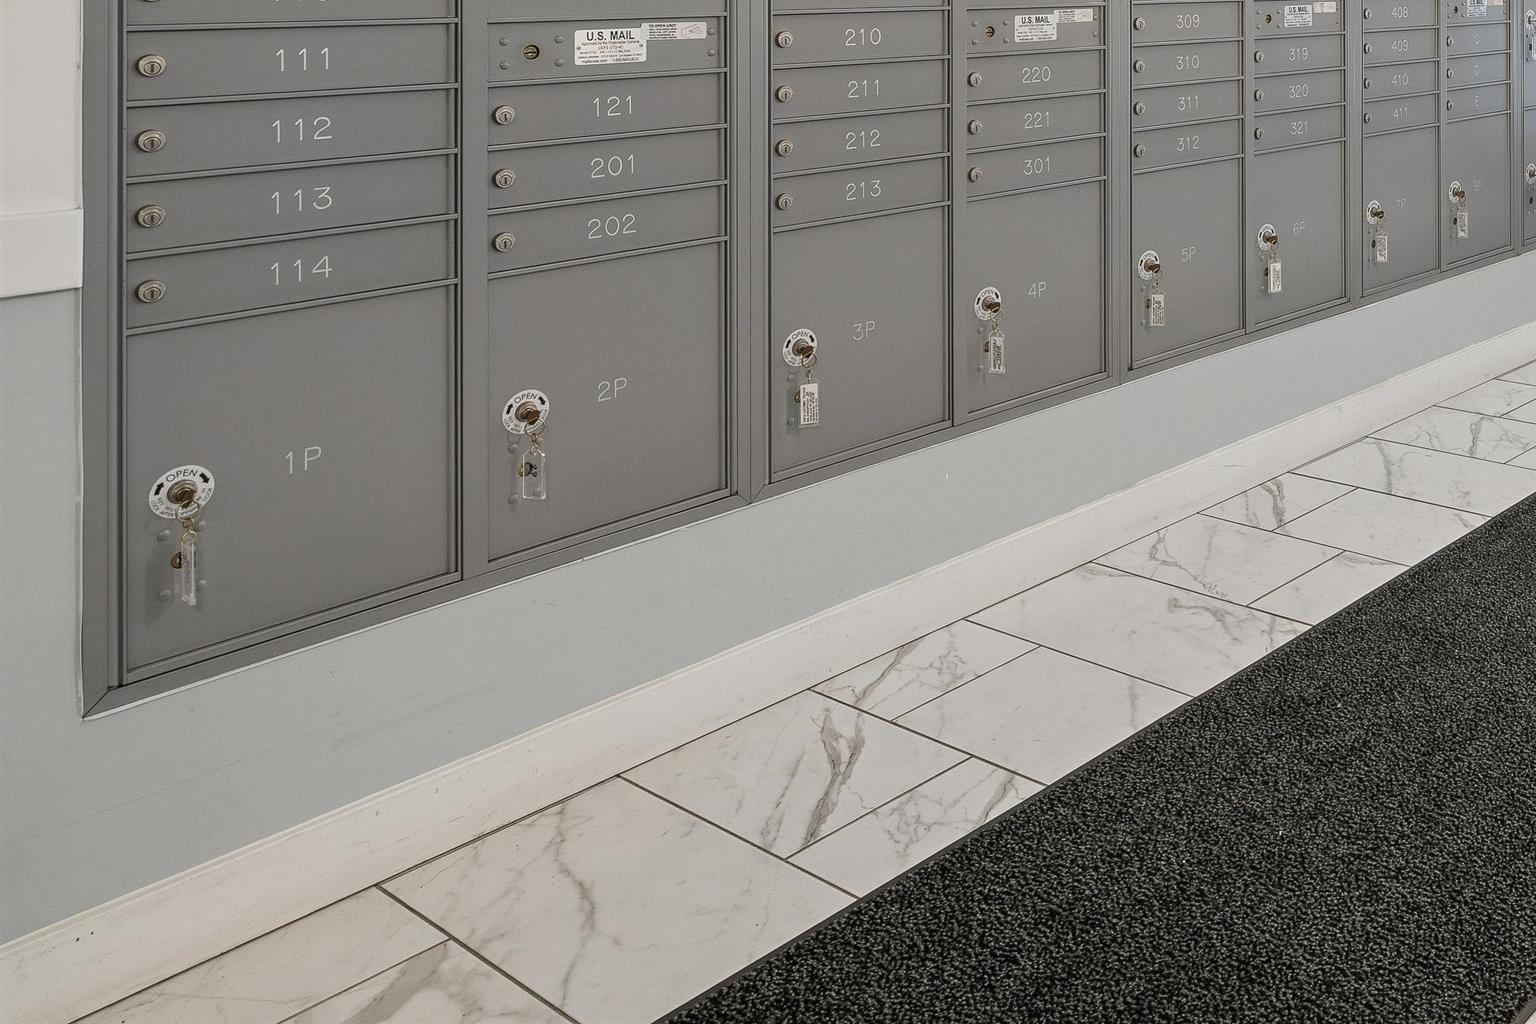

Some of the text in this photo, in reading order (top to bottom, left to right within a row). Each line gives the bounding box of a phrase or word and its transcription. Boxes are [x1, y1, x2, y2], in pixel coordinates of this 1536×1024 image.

[1392, 7, 1408, 18] 408
[1177, 15, 1199, 28] 309
[587, 31, 635, 41] U.S. MAIL
[846, 28, 881, 46] 210
[1392, 40, 1408, 51] 409
[276, 48, 328, 71] 111
[1289, 48, 1308, 60] 319
[1176, 55, 1199, 69] 310
[1022, 67, 1050, 83] 220
[1392, 74, 1408, 85] 410
[848, 80, 878, 98] 211
[1289, 84, 1308, 98] 320
[594, 96, 631, 117] 121
[1178, 96, 1198, 110] 311
[1025, 112, 1048, 128] 221
[1393, 107, 1407, 119] 411
[273, 117, 332, 142] 112
[1291, 121, 1307, 134] 321
[846, 130, 880, 149] 212
[1177, 136, 1199, 151] 312
[591, 155, 633, 178] 201
[1024, 157, 1049, 175] 301
[846, 180, 881, 200] 213
[272, 187, 332, 214] 113
[1396, 198, 1406, 209] 7P
[588, 214, 636, 239] 202
[1293, 222, 1305, 235] 6P
[1181, 247, 1196, 262] 5P
[271, 256, 332, 285] 114
[980, 289, 994, 297] OPEN
[1028, 282, 1046, 298] 4P
[791, 330, 809, 340] OPEN
[853, 321, 875, 340] 3P
[598, 378, 627, 401] 2P
[514, 392, 538, 403] OPEN
[286, 447, 321, 473] 1P
[166, 469, 198, 482] OPEN
